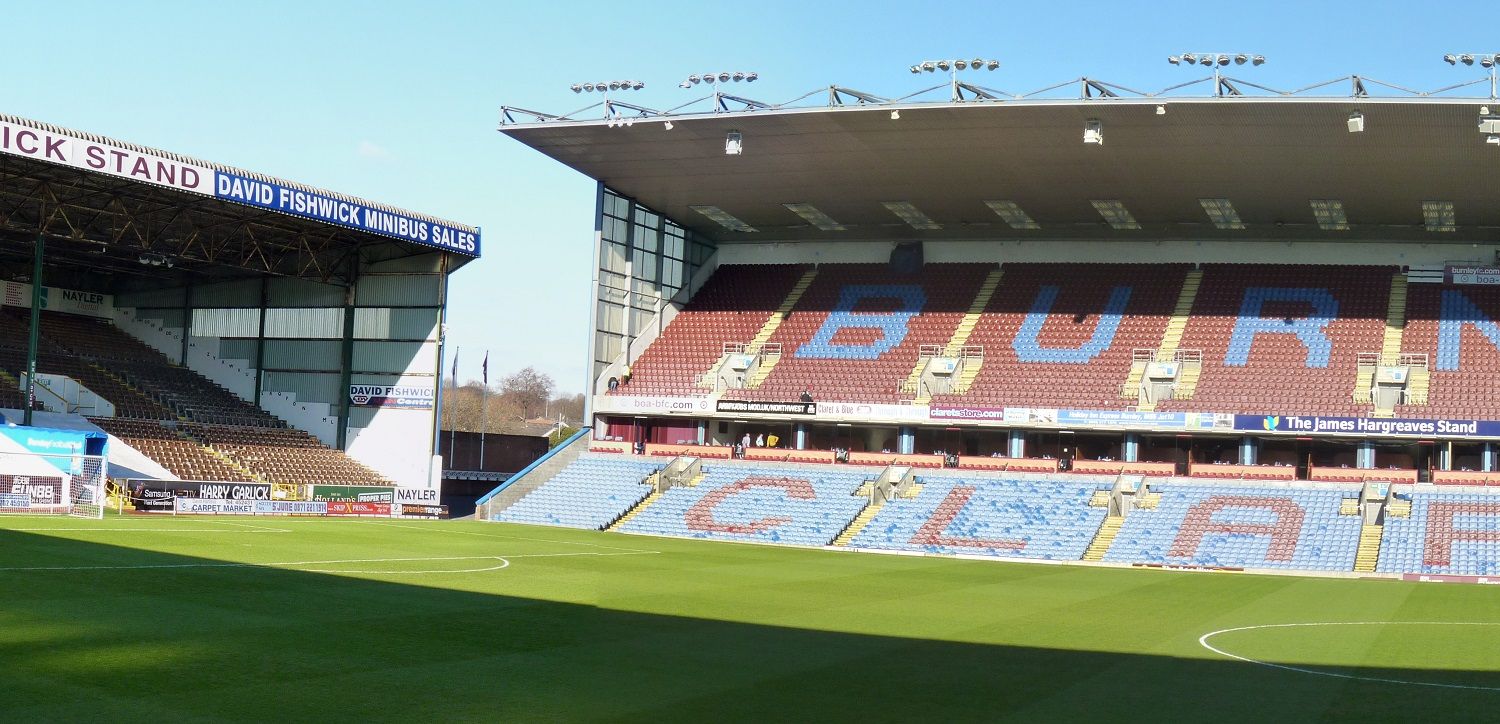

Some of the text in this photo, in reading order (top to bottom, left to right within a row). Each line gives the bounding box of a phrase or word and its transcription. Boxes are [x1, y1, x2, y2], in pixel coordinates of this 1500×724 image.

[3, 126, 200, 189] ICK STAND
[218, 175, 475, 252] DAVID FISHWICK MINIBUS SALES
[1452, 267, 1500, 275] burnleyfc.com
[63, 290, 104, 305] NAYLER
[350, 386, 382, 395] DAVID
[634, 399, 693, 409] boa-bfc.com
[818, 405, 834, 414] Claret
[1069, 411, 1089, 421] Holiday
[1286, 416, 1477, 434] The James Hargreaves Stand
[145, 489, 172, 499] Samsung
[200, 484, 268, 501] HARRY GARLICK
[397, 489, 436, 501] NAYLER
[359, 495, 380, 503] PROPER
[192, 504, 221, 513] CARPET
[223, 504, 253, 513] MARKET
